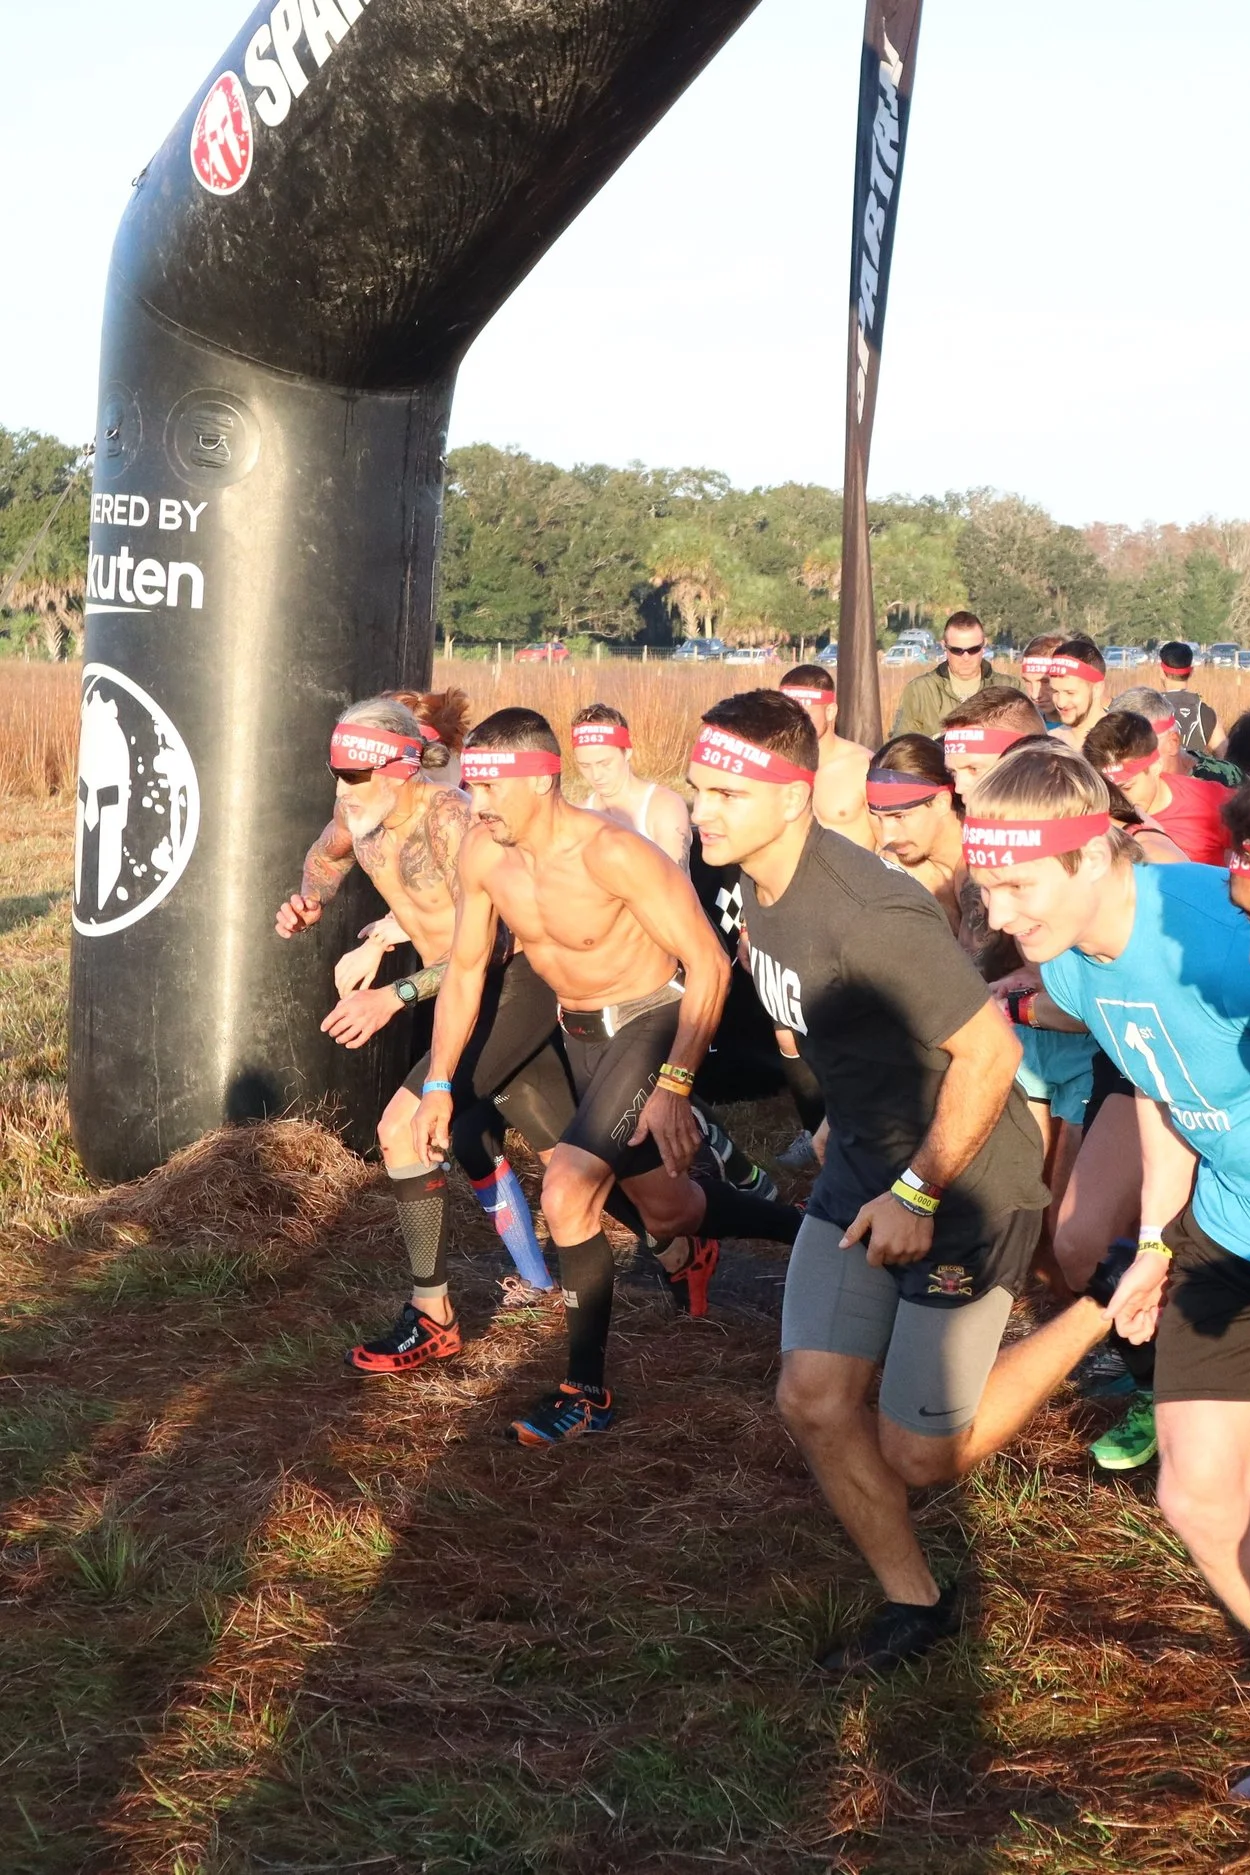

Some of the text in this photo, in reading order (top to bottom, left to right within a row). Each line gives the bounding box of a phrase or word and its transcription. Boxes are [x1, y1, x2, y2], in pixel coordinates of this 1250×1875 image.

[90, 493, 209, 532] ERED BY
[342, 734, 399, 758] SPARTAN
[348, 749, 387, 765] 0088
[711, 731, 771, 768] SPARTAN
[701, 747, 744, 774] 3013
[968, 829, 1042, 847] SPARTAN
[967, 850, 1015, 866] 3014
